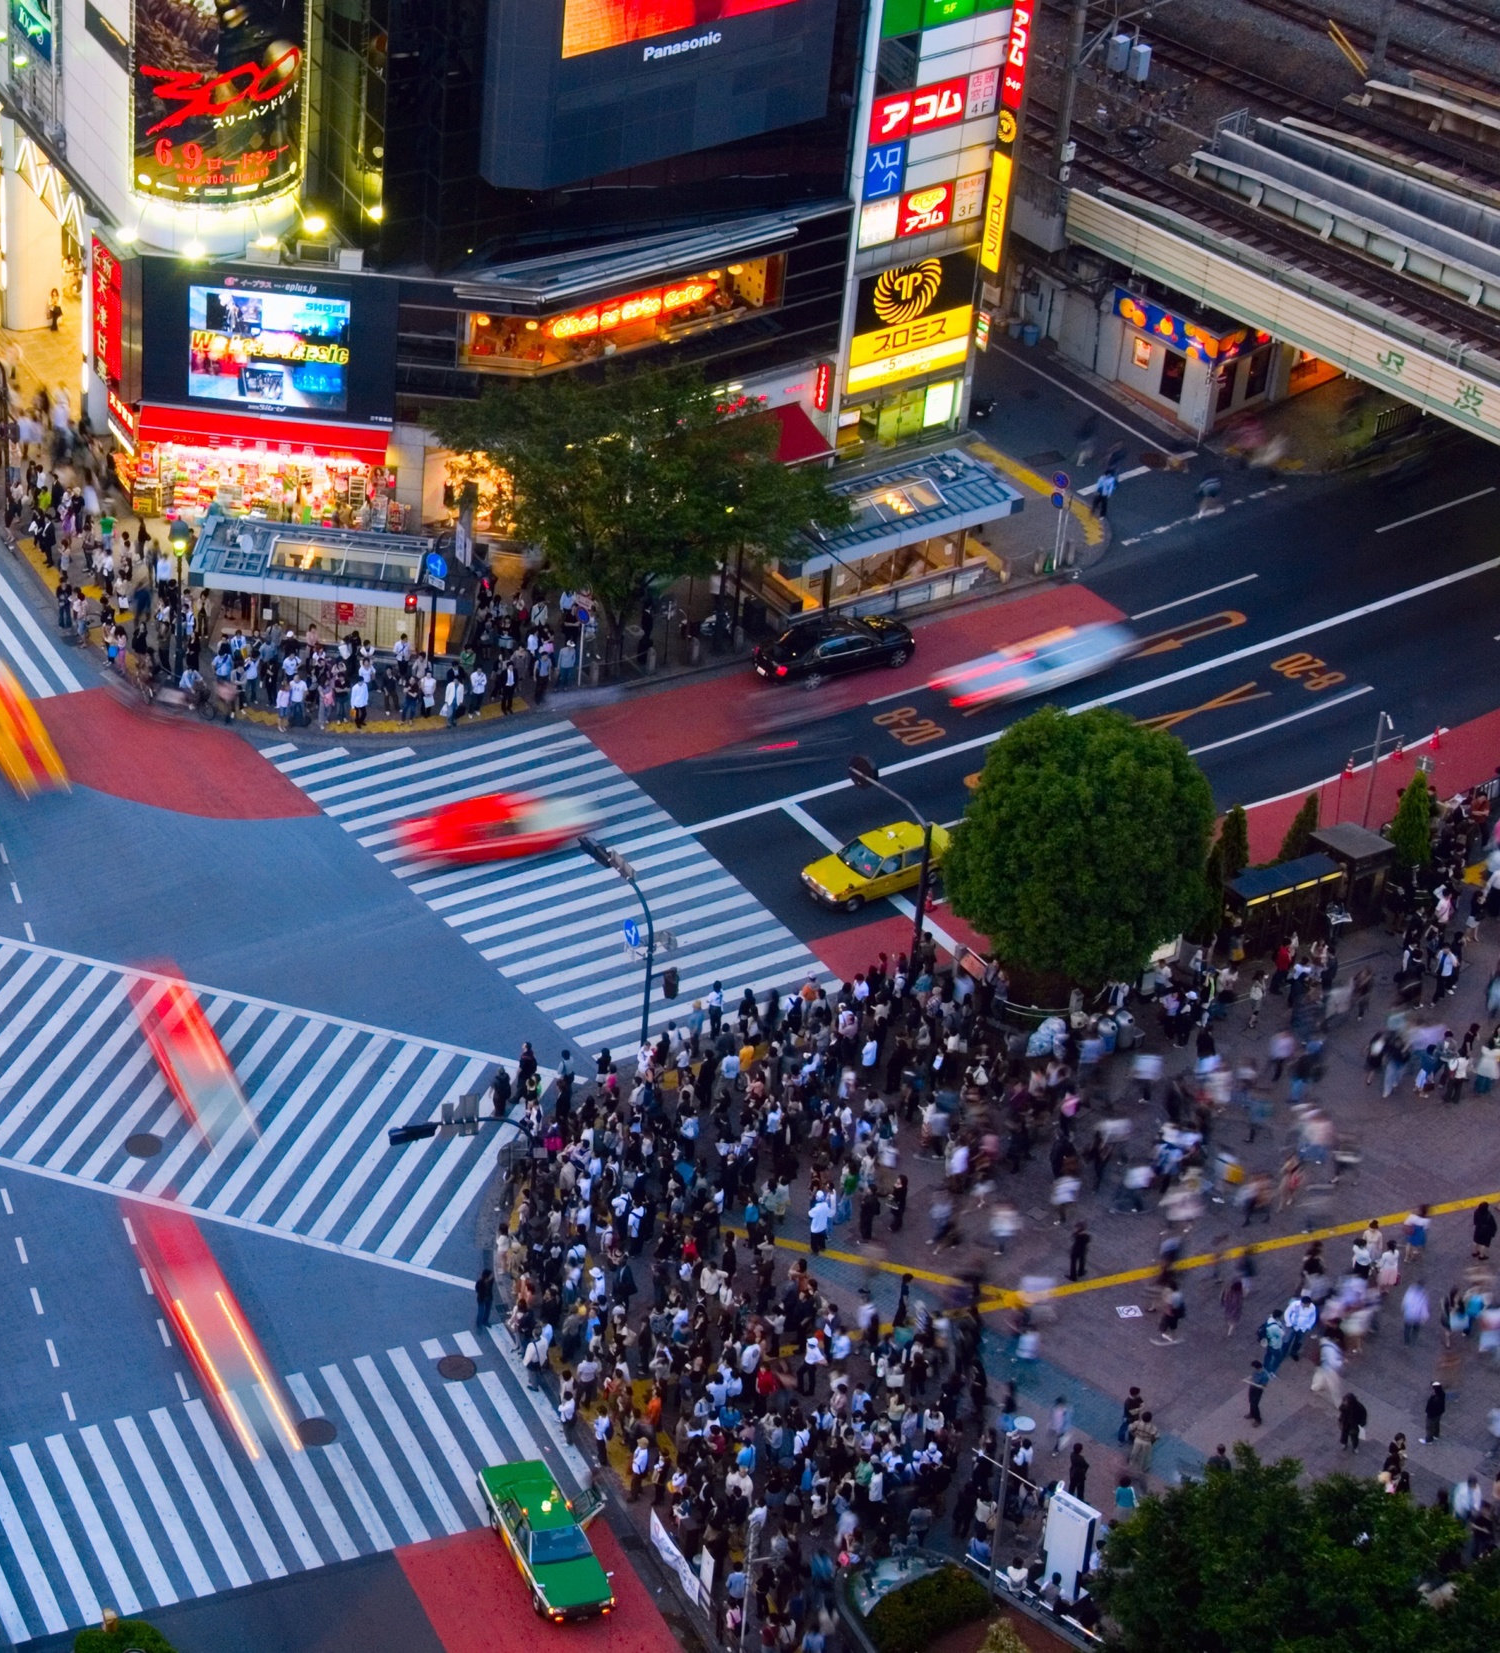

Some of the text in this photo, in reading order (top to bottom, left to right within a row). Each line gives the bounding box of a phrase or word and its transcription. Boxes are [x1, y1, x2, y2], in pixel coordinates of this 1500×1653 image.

[943, 3, 957, 14] 5F
[643, 31, 722, 62] Panasonic
[1009, 9, 1029, 67] アコム
[139, 47, 300, 136] 300
[971, 71, 995, 87] 店頭
[212, 80, 300, 130] スリーハンドレッド
[881, 89, 963, 134] アコム
[155, 138, 290, 170] 6.9 ロードショー
[869, 147, 902, 172] 入口
[905, 210, 944, 232] アコム
[986, 194, 1004, 257] プロミス
[285, 283, 317, 295] eplus.jp
[873, 317, 948, 355] プロミス
[1377, 351, 1405, 373] JR
[1453, 380, 1485, 418] 渋
[172, 433, 195, 443] クスリ
[1270, 652, 1348, 692] 8-20
[872, 706, 947, 747] 8-20
